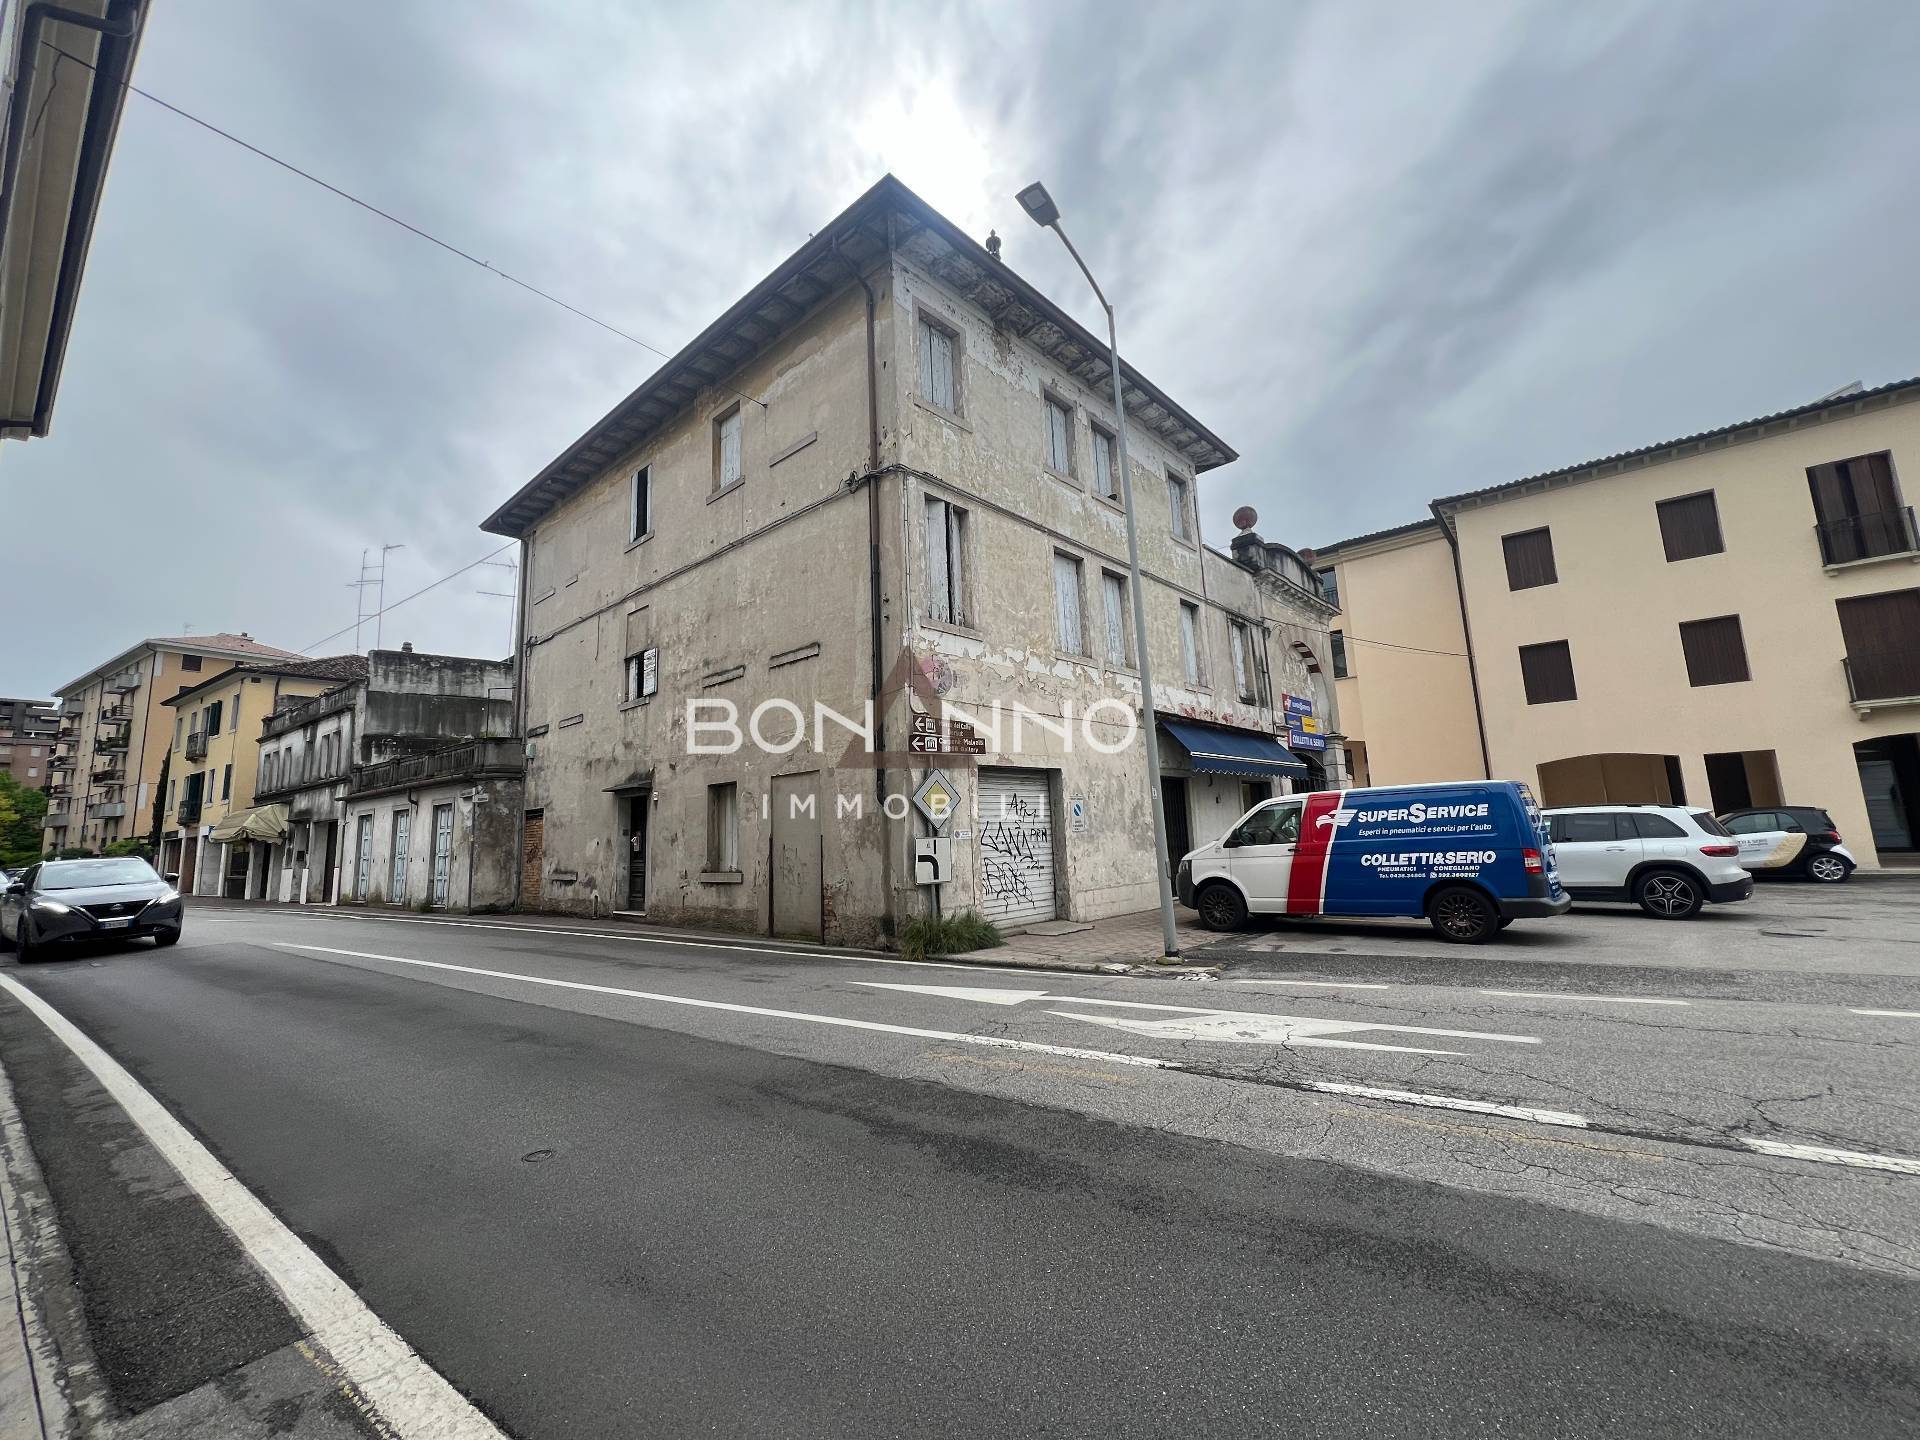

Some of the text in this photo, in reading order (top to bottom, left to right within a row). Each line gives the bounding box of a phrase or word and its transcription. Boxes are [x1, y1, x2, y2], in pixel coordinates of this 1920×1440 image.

[1357, 803, 1489, 823] SUPERSERVICE
[1358, 827, 1381, 837] Esperti
[1381, 827, 1388, 835] in
[1389, 825, 1427, 836] pneumatici
[1432, 824, 1456, 833] servizi
[1457, 825, 1469, 834] per
[1470, 823, 1492, 831] l'auto
[1360, 850, 1497, 867] COLLETTI&SERIO
